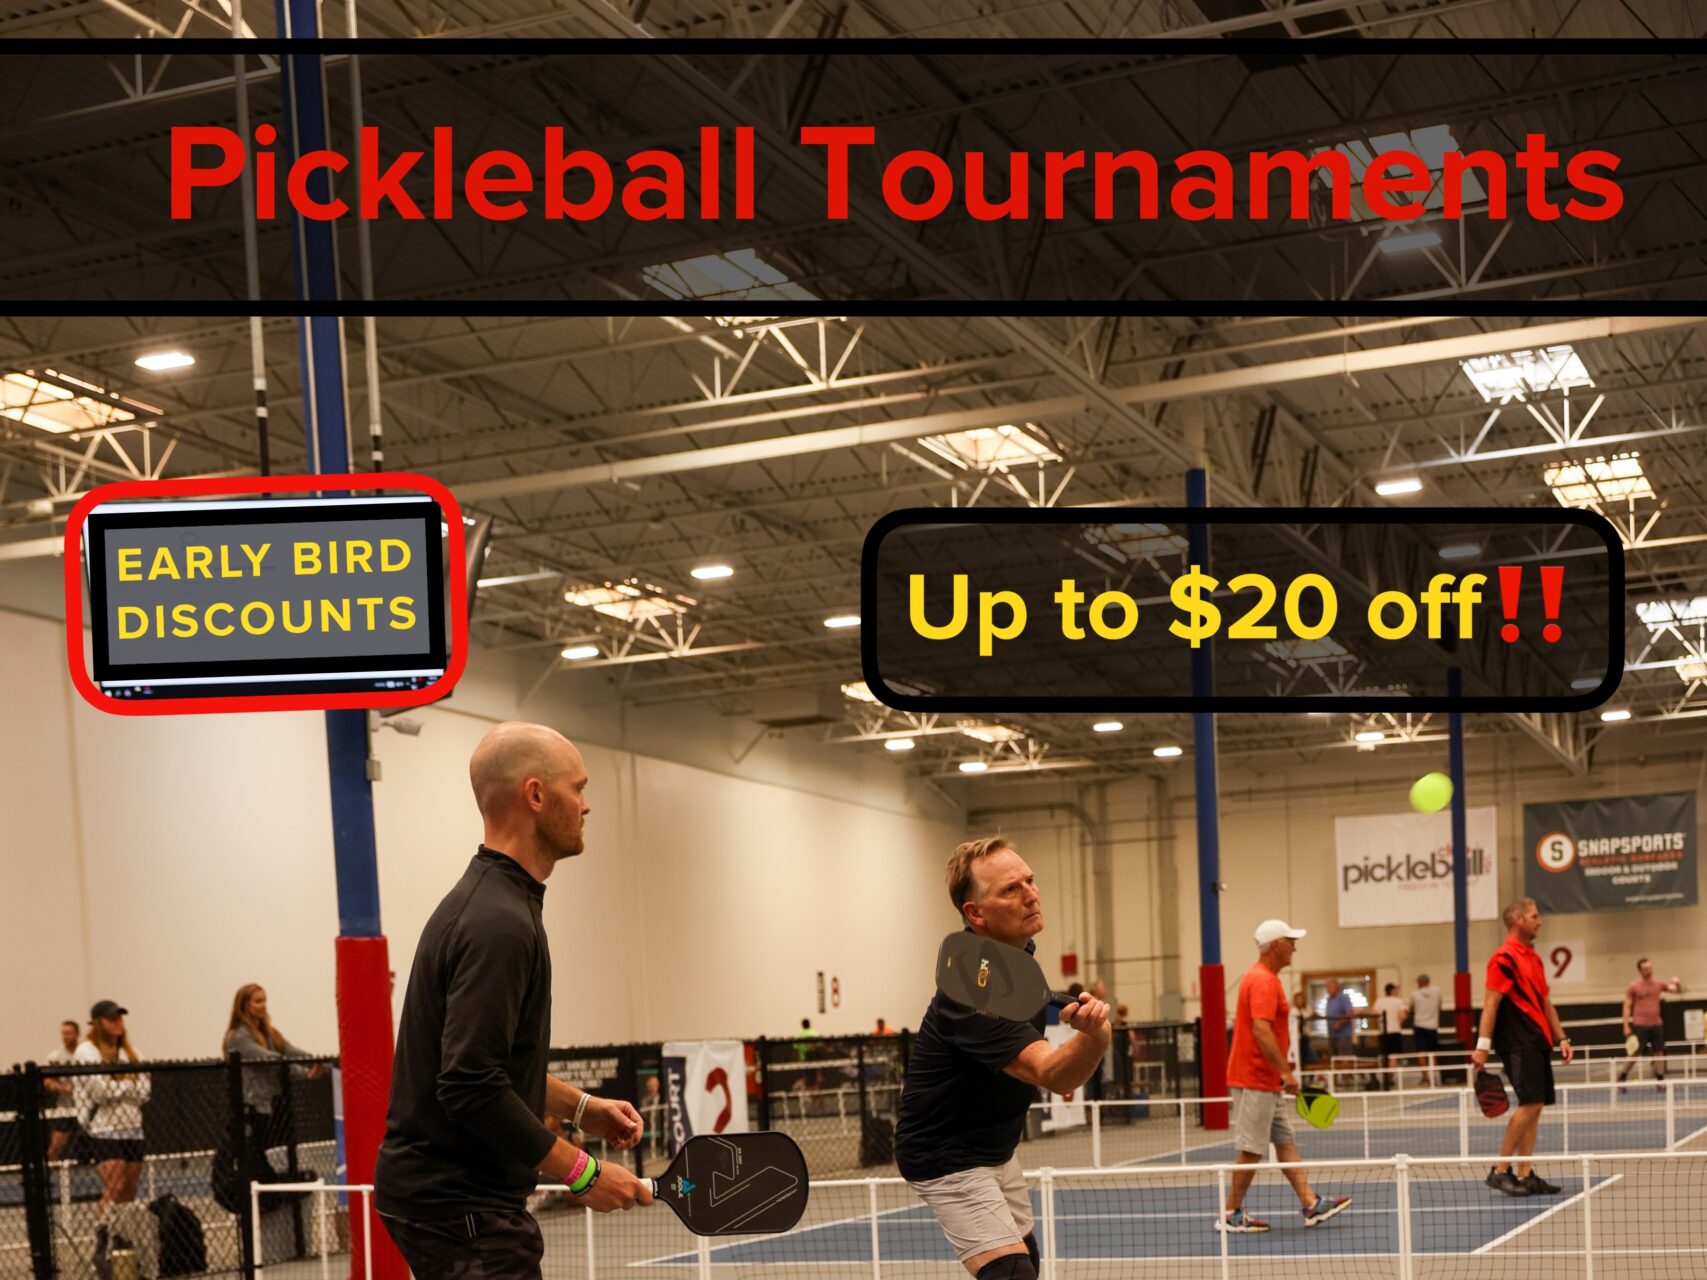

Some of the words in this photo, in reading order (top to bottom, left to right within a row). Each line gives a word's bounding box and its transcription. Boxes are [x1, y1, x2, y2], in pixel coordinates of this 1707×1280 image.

[1551, 841, 1563, 861] S
[1578, 832, 1684, 857] SNAPSPORTS
[1551, 946, 1572, 979] 9
